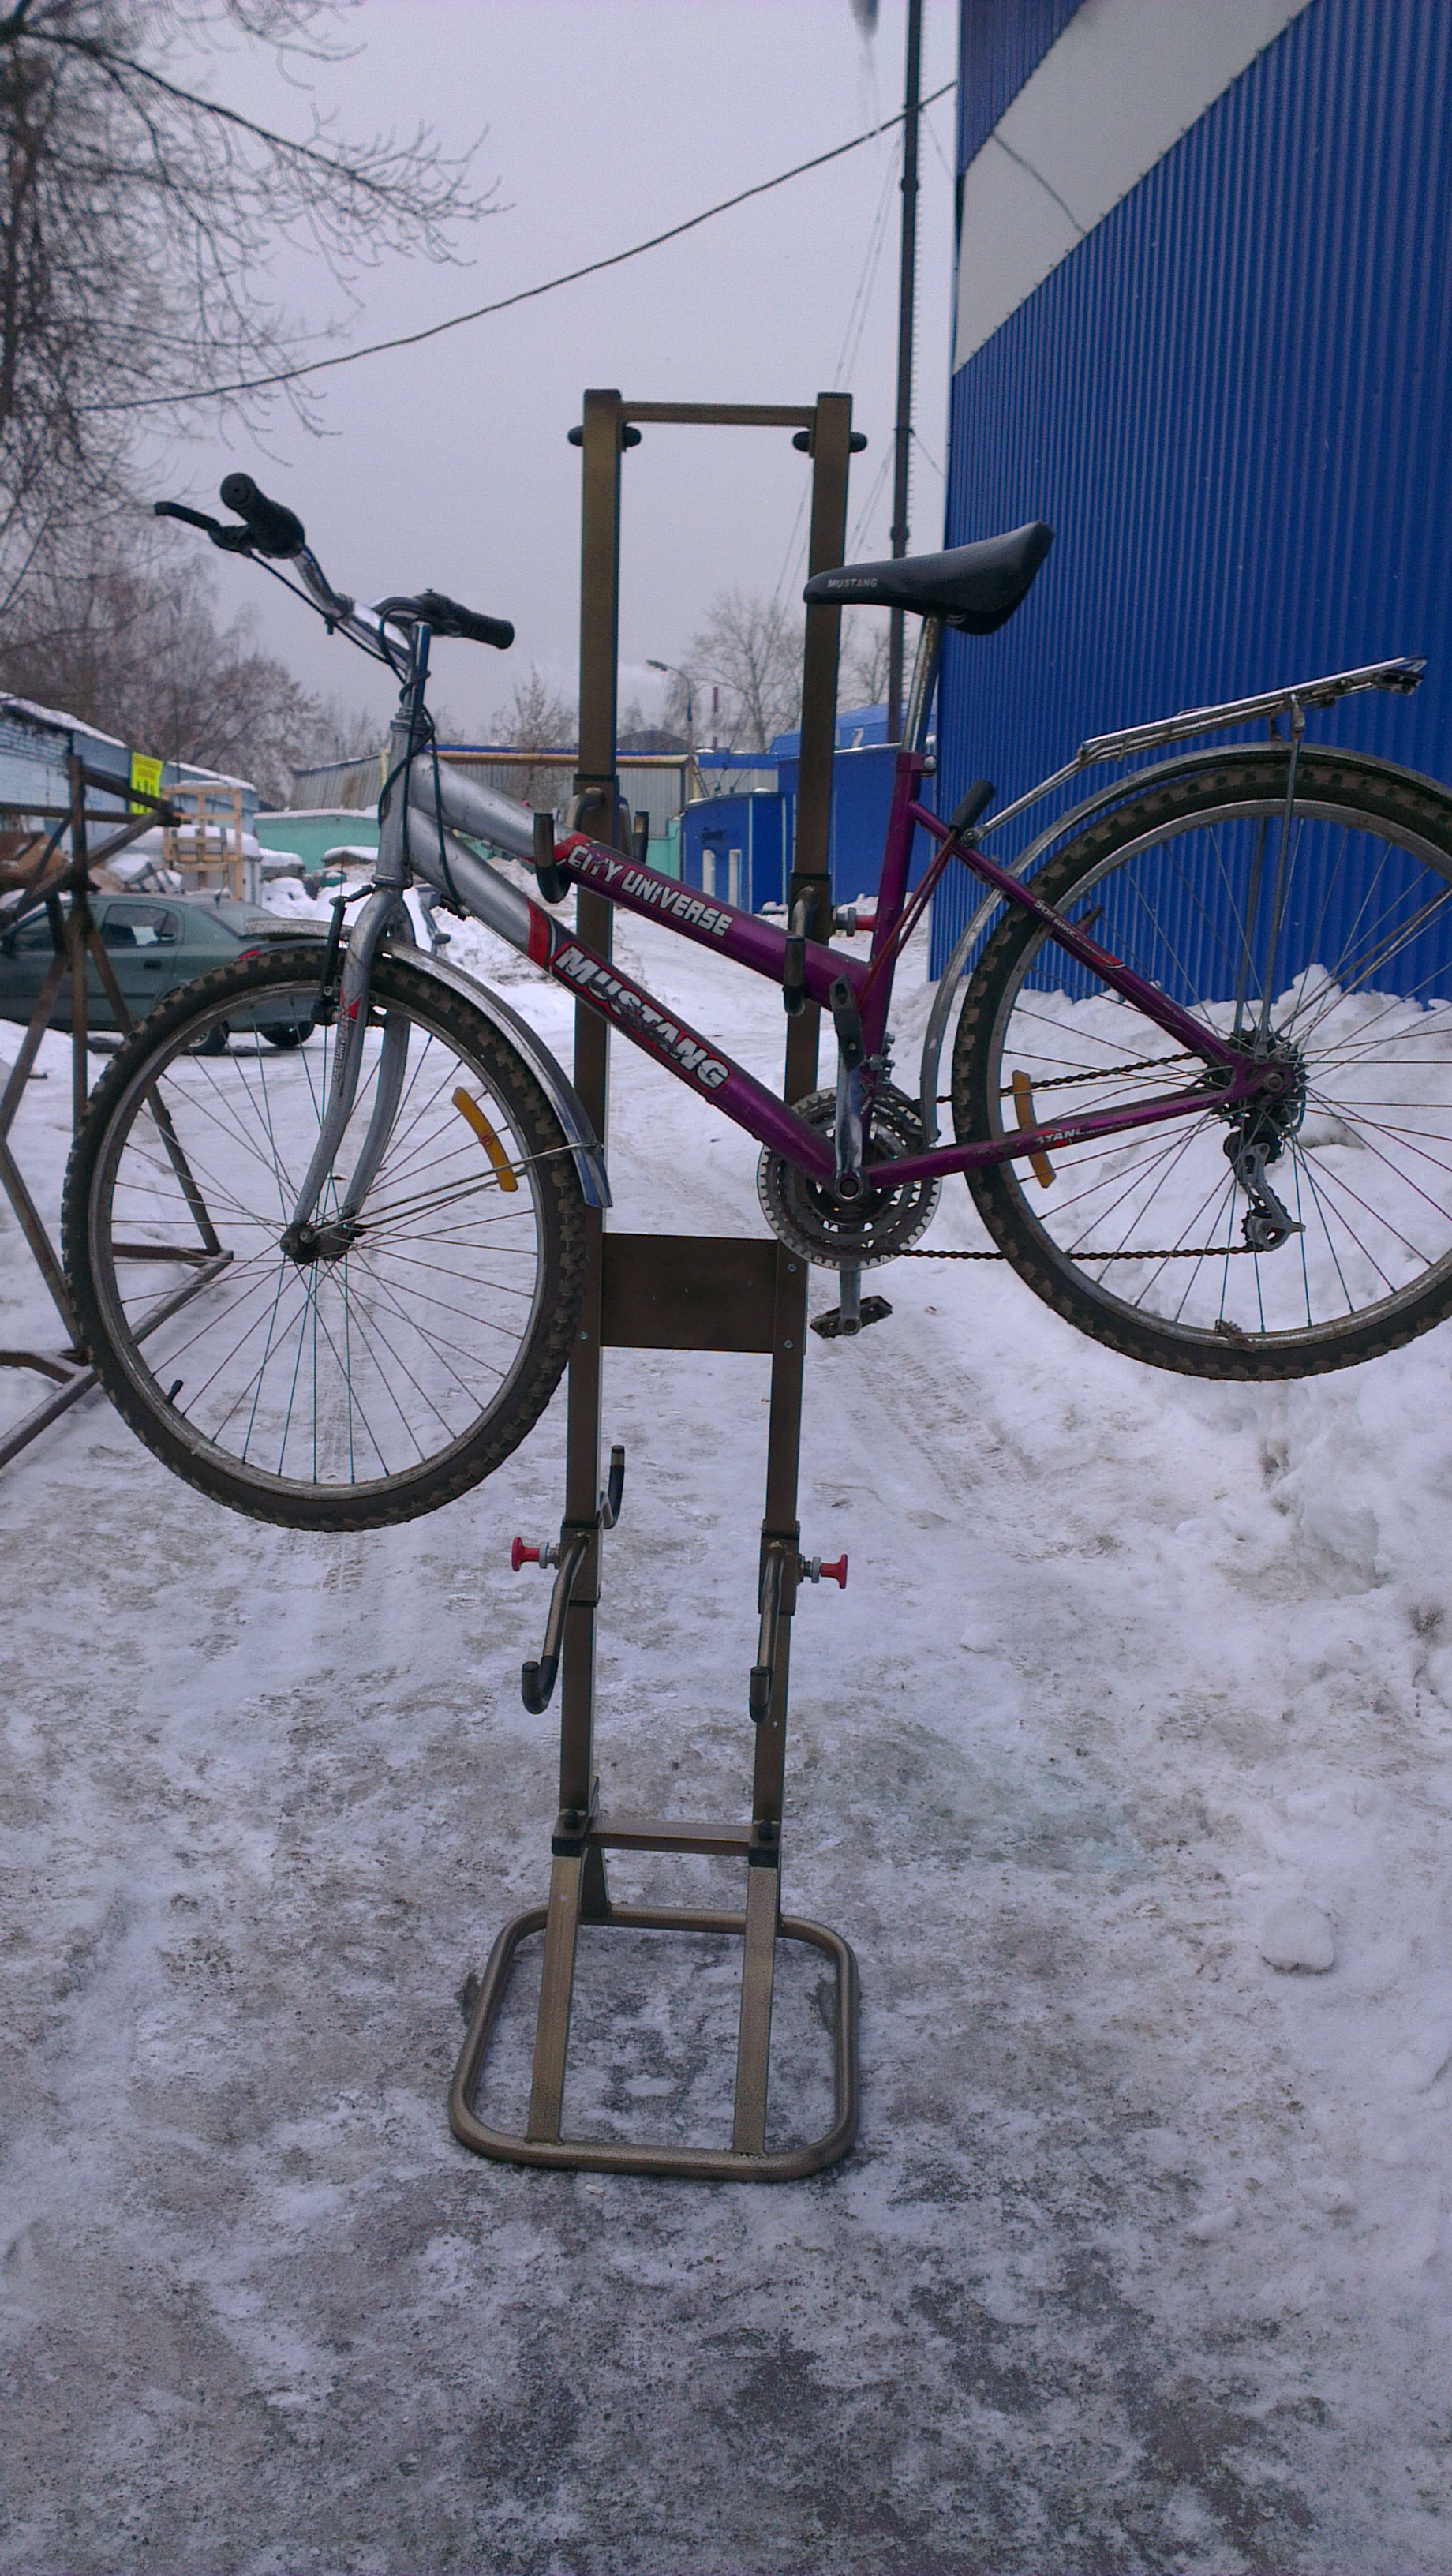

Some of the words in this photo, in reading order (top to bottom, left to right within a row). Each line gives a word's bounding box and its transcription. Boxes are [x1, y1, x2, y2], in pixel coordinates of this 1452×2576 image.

[827, 578, 878, 588] MUSTANG
[567, 844, 625, 883] CITY
[619, 869, 734, 938] UNIVERSE
[554, 946, 729, 1088] MUSTANG
